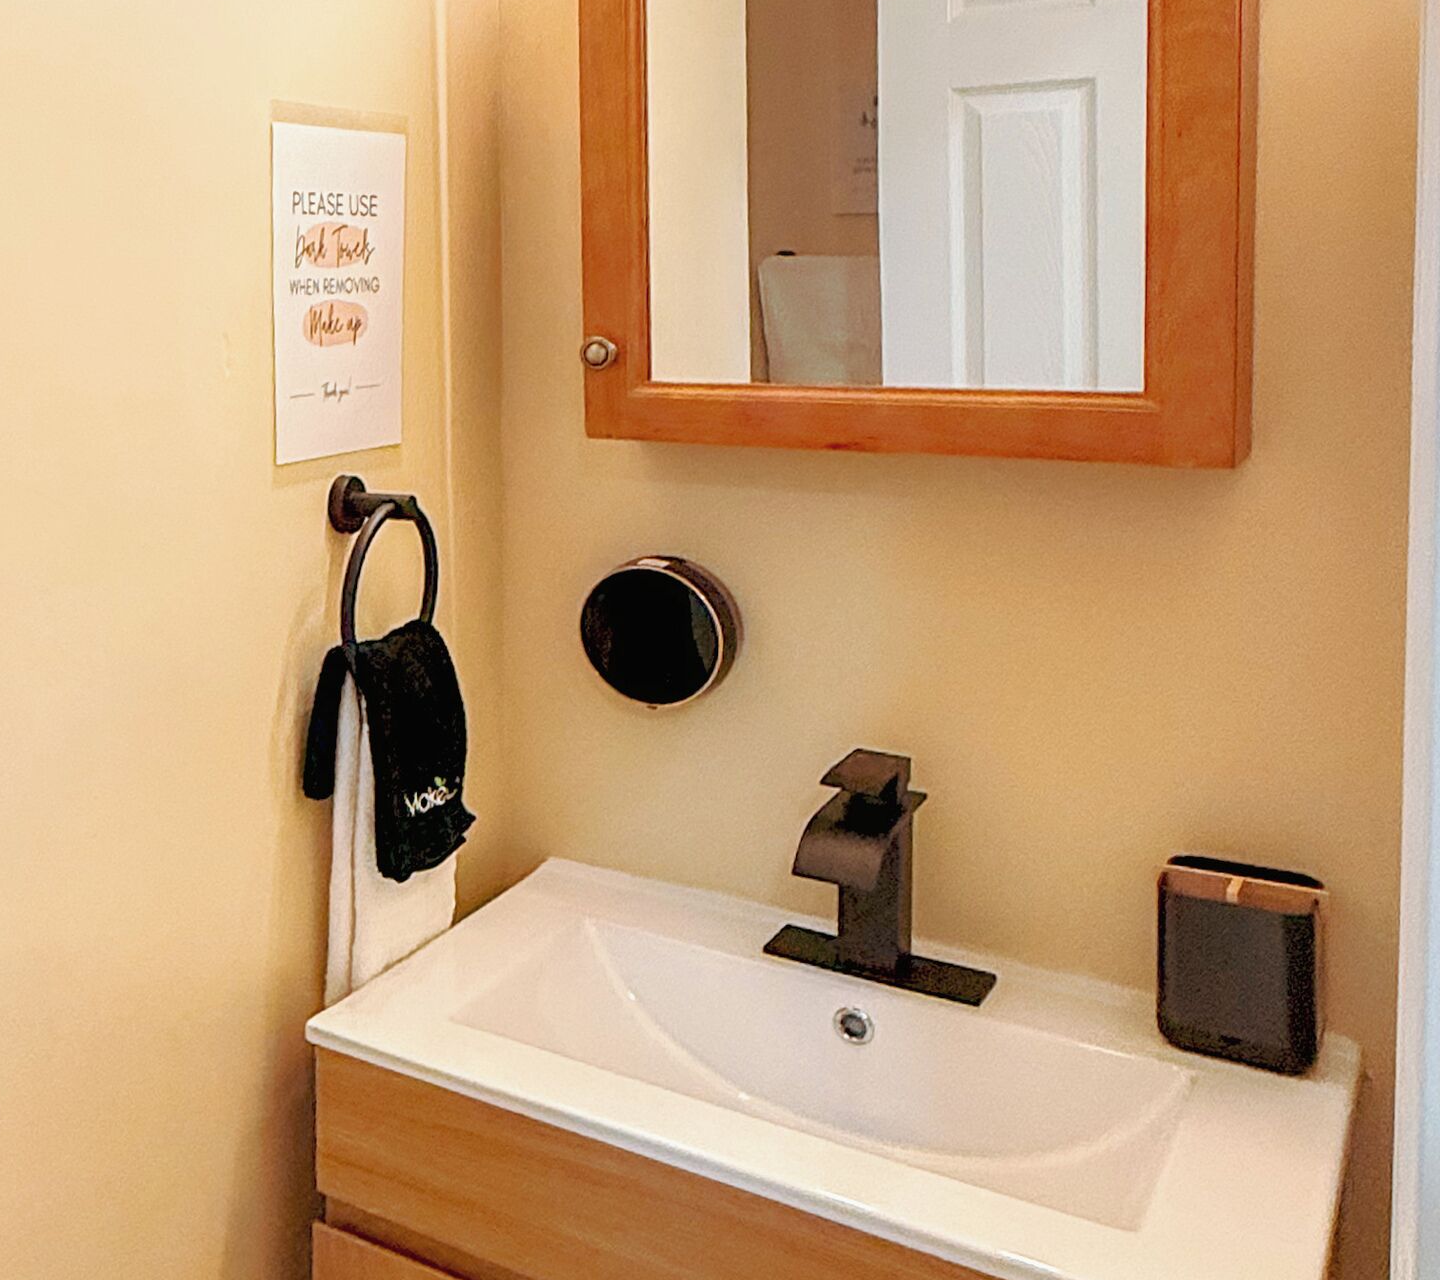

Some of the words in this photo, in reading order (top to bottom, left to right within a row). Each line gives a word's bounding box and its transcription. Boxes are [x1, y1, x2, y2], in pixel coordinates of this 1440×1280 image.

[292, 191, 344, 216] PLEASE
[349, 194, 378, 217] USE
[295, 224, 327, 269] Dark
[332, 224, 375, 268] Towels
[289, 278, 320, 296] WHEN
[323, 276, 380, 294] REMOVING
[310, 303, 344, 347] Make
[347, 314, 362, 346] up
